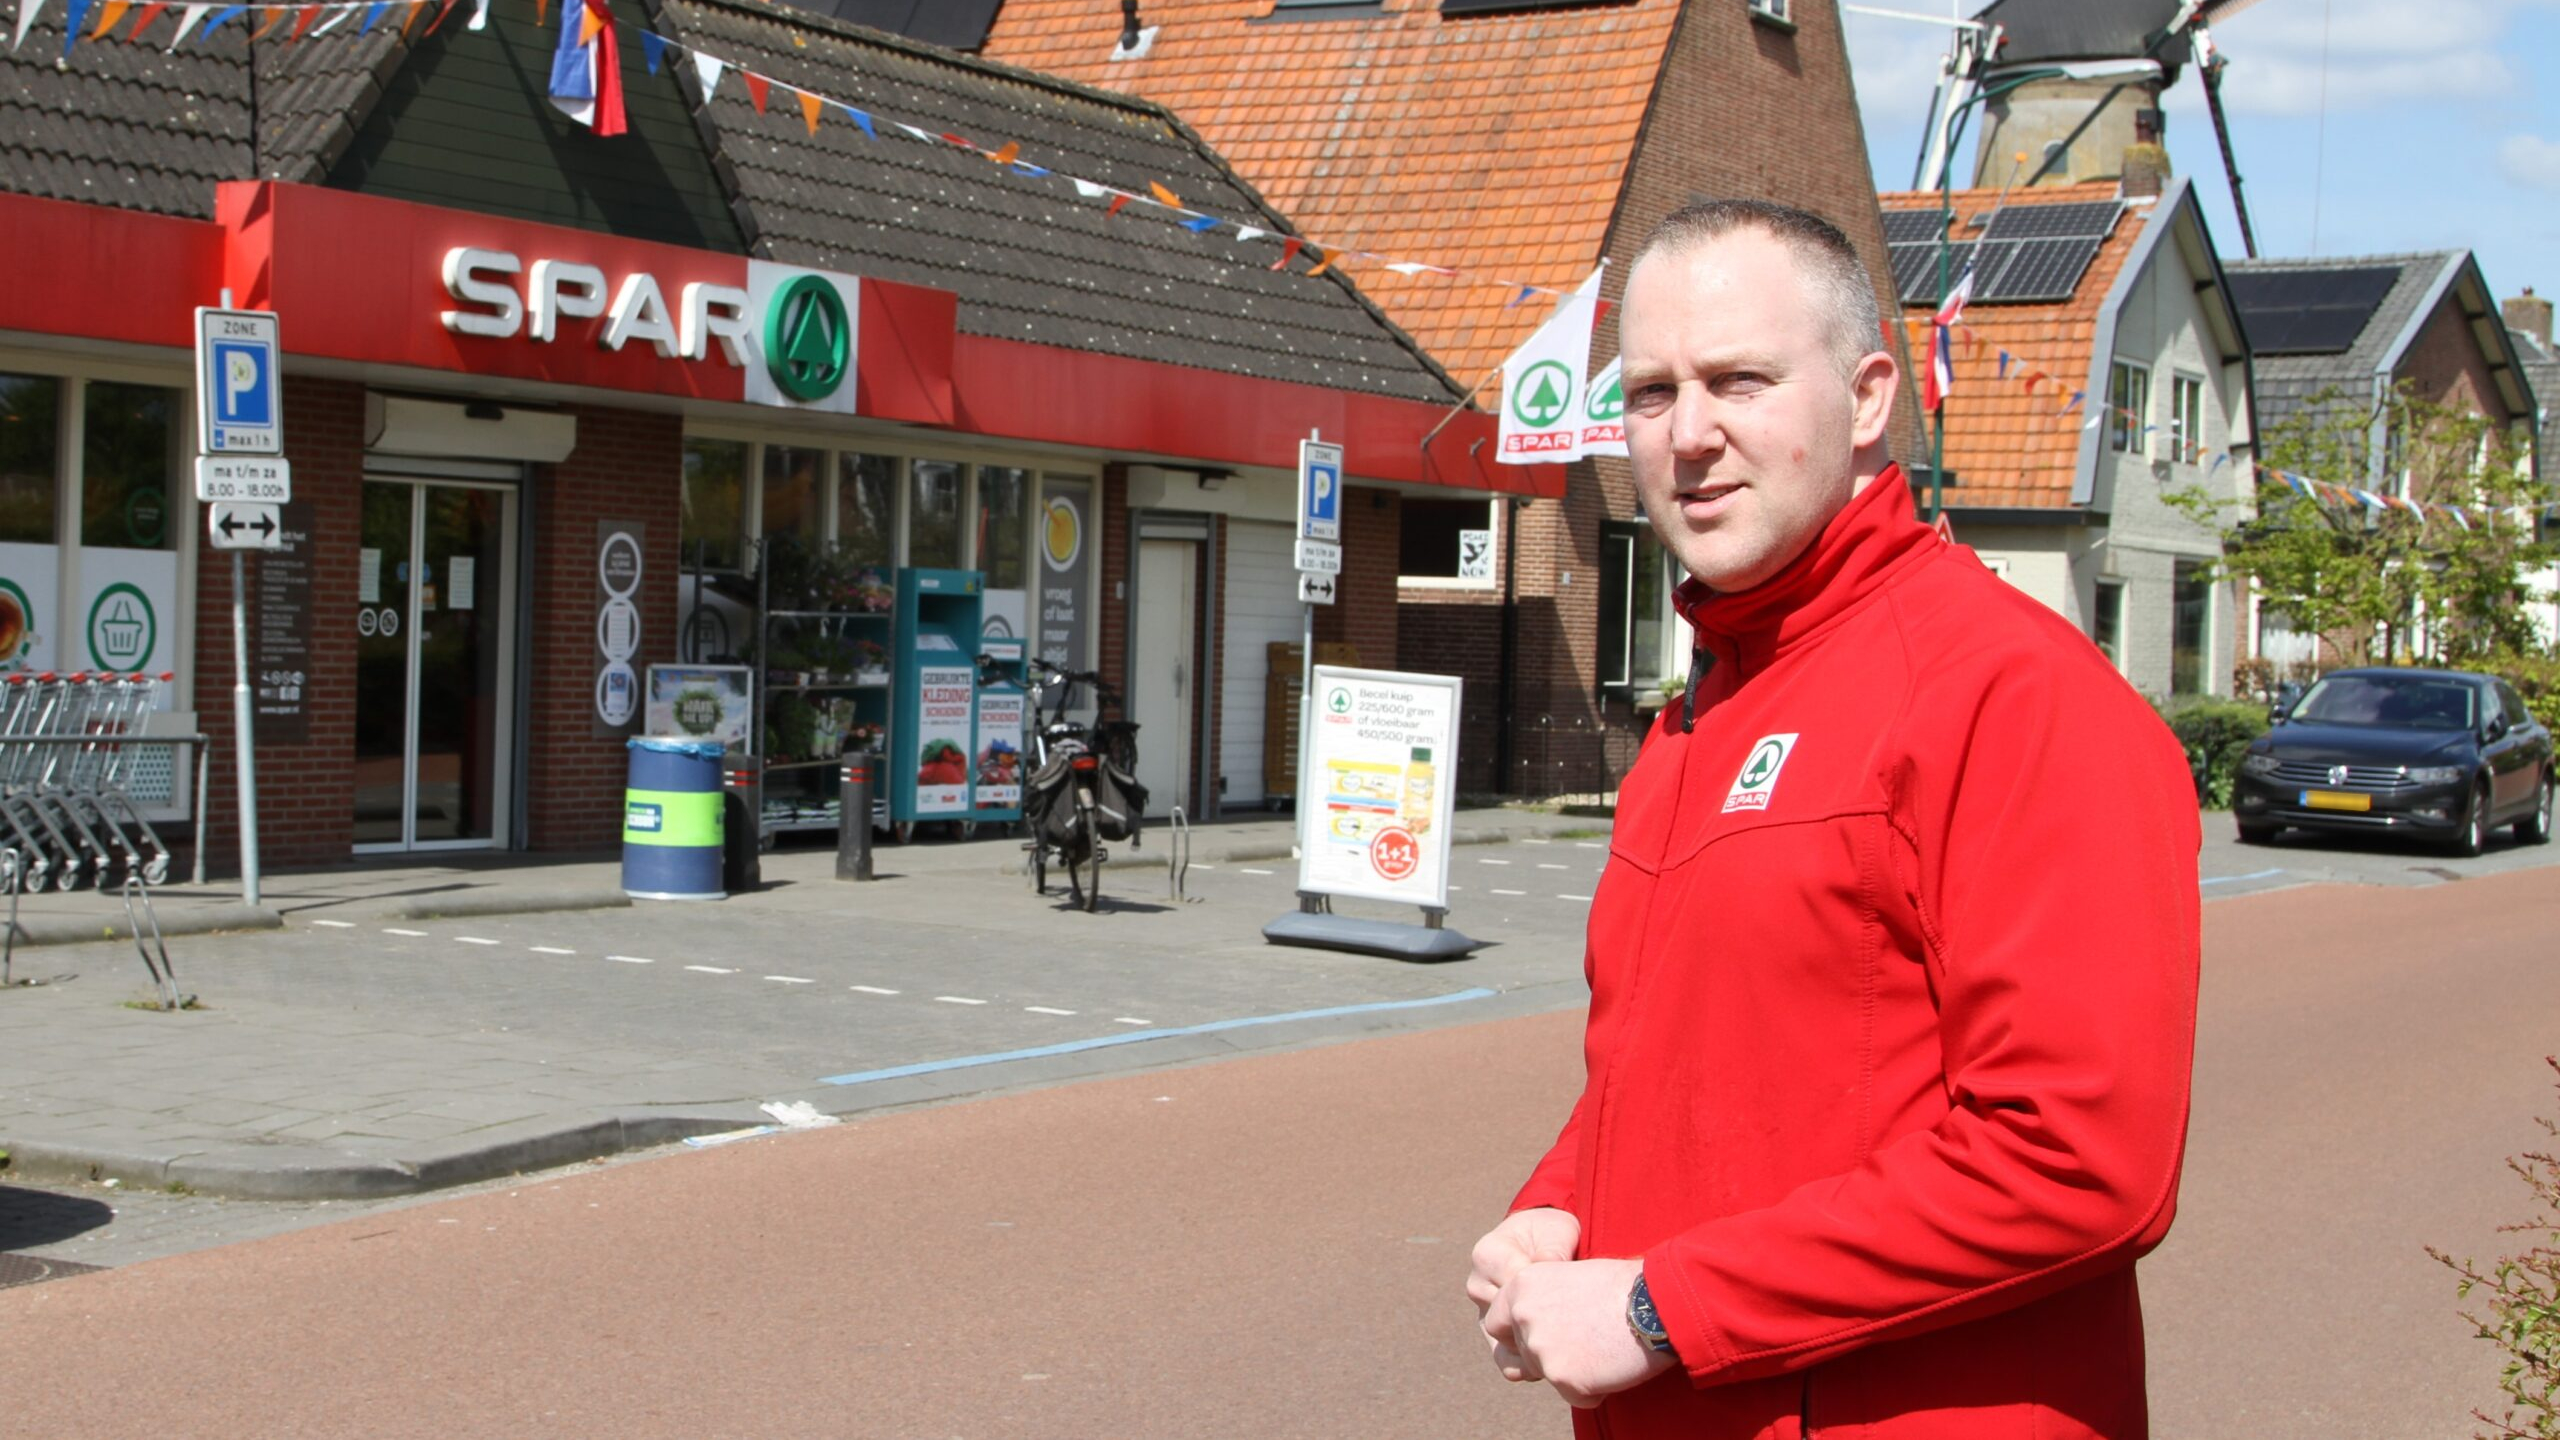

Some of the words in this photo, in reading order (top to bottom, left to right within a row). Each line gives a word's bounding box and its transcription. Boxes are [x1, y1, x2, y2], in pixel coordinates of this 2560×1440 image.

[441, 246, 752, 366] SPAR
[224, 320, 257, 335] ZONE
[225, 350, 258, 416] P
[229, 434, 255, 445] max
[263, 434, 270, 446] h
[1506, 433, 1572, 451] SPAR
[1314, 450, 1333, 461] ZONE
[214, 465, 232, 477] ma
[236, 464, 260, 479] t/m
[263, 467, 277, 479] za
[207, 483, 235, 497] 8.00
[246, 484, 285, 498] 18.00h
[1313, 470, 1331, 514] P
[923, 672, 971, 685] GEBRUIKTE
[922, 687, 970, 703] KLEDING
[1359, 688, 1389, 700] Becel
[1391, 689, 1413, 702] kuip
[1358, 701, 1404, 715] 225/600
[1406, 707, 1434, 717] gram
[1358, 715, 1369, 725] of
[1371, 716, 1420, 729] vloeibaar
[1357, 728, 1404, 742] 450/500
[1726, 793, 1767, 808] SPAR
[1377, 842, 1413, 862] 1+1
